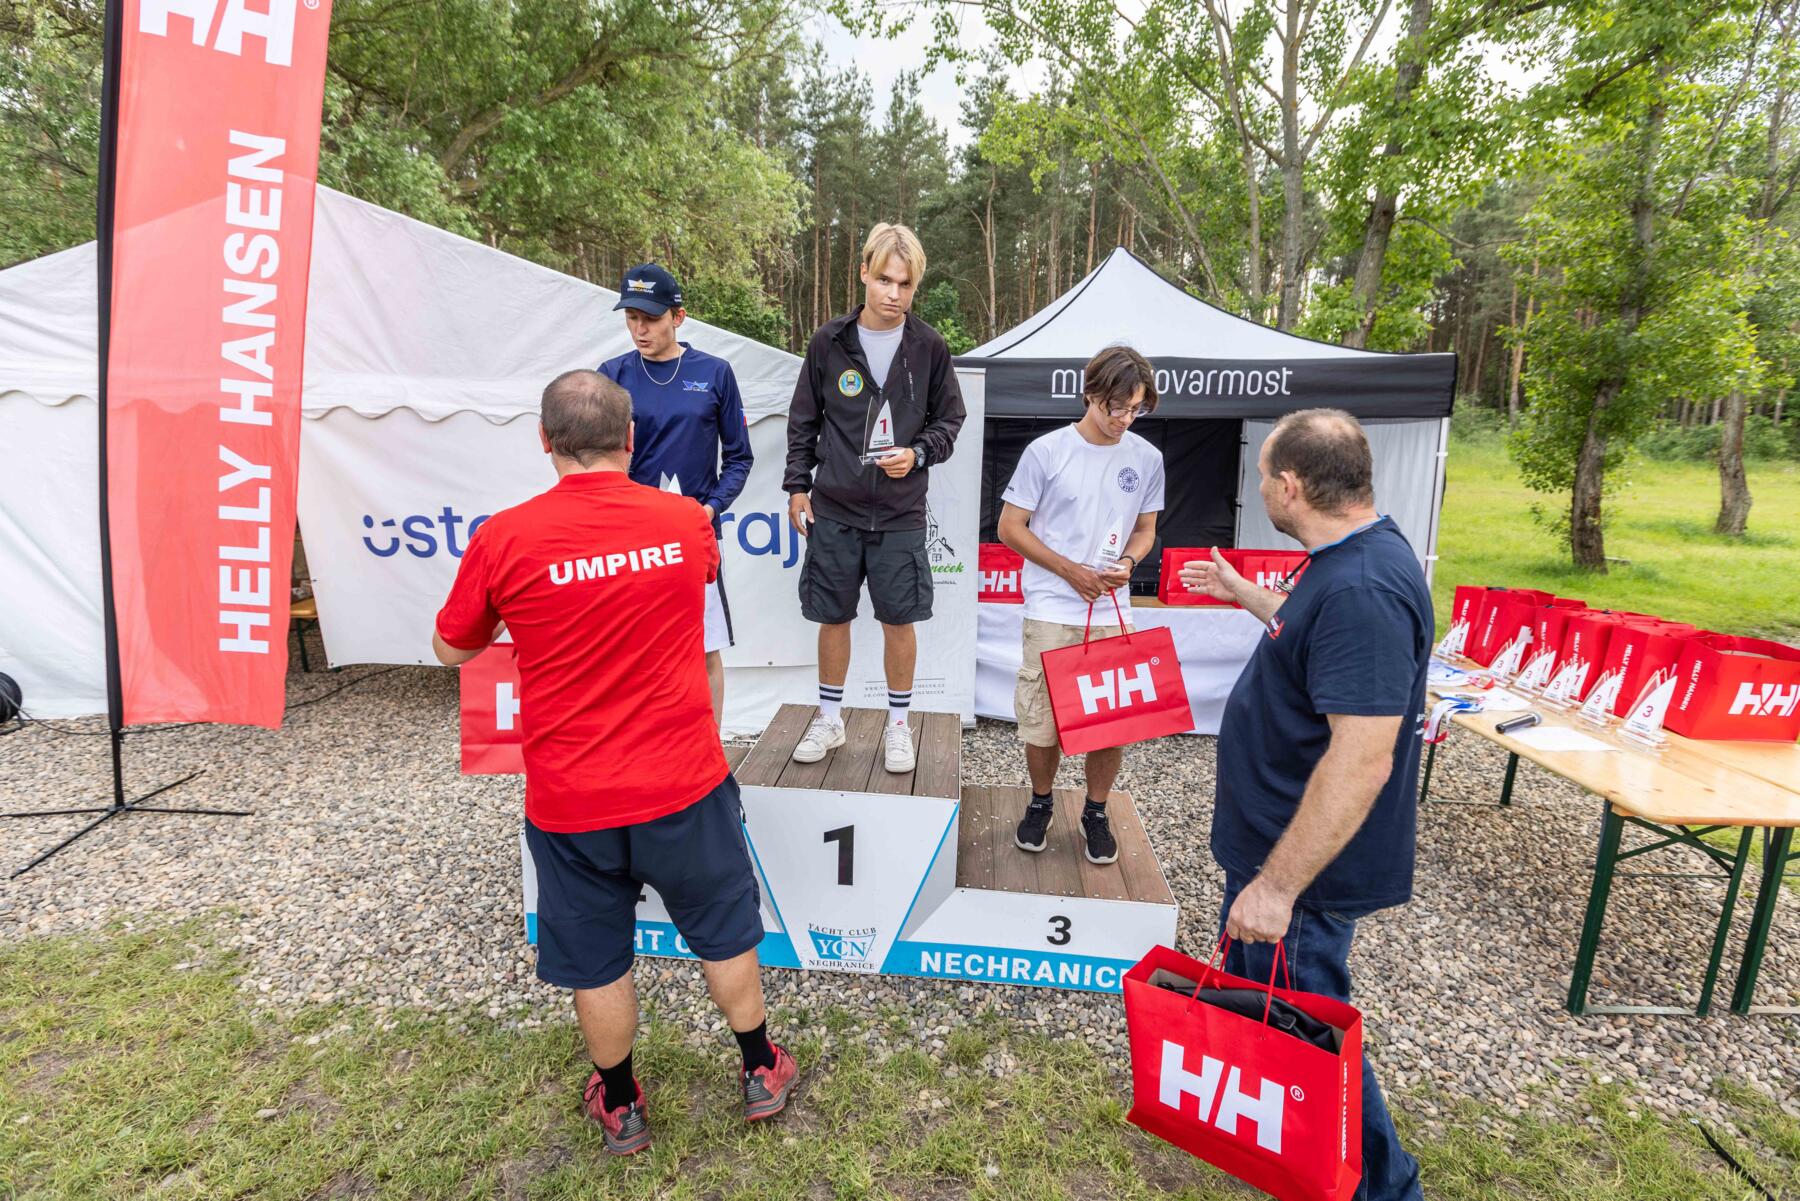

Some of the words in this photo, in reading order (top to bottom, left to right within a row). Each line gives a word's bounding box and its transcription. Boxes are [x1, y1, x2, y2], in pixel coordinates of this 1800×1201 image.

[219, 130, 286, 426] HANSEN
[879, 418, 887, 434] 1
[218, 444, 271, 654] HELLY
[1109, 533, 1117, 545] 3
[549, 541, 684, 585] UMPIRE
[978, 570, 1017, 593] HH
[1693, 660, 1703, 683] HELLY
[1076, 662, 1158, 716] HH
[1593, 694, 1602, 705] 3
[1680, 682, 1696, 711] HANSEN
[1642, 705, 1655, 718] 3
[823, 824, 855, 887] 1
[808, 922, 844, 936] YACHT
[848, 927, 877, 936] CLUB
[1046, 915, 1072, 946] 3
[816, 939, 867, 957] YCN
[1159, 1039, 1285, 1156] HH
